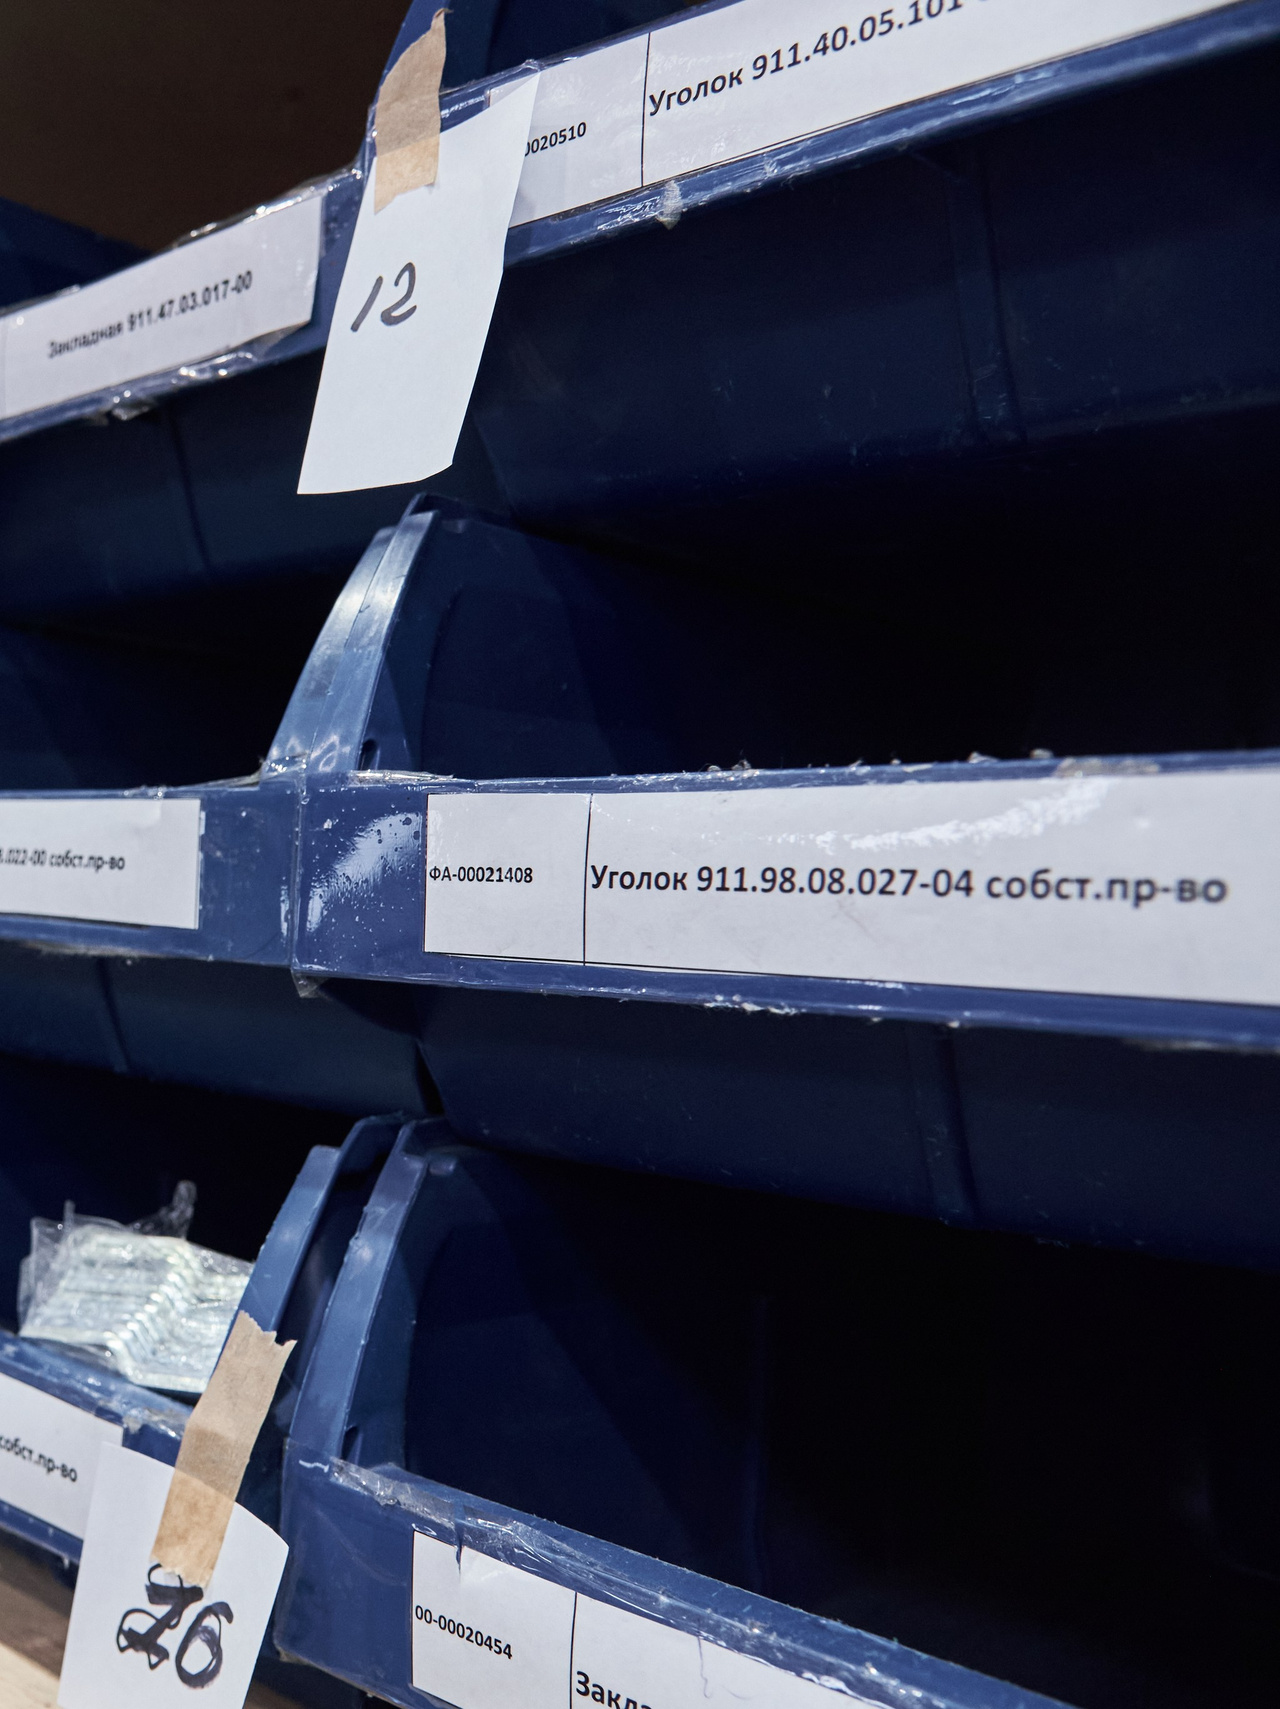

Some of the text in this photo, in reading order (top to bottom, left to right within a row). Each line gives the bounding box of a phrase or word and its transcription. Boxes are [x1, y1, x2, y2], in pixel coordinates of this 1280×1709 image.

[648, 67, 743, 116] Уголок
[48, 270, 254, 359] Закладная 911.47.03.017-00
[350, 262, 417, 332] 12
[49, 848, 126, 874] собст.пр-во
[429, 864, 1228, 909] ФА-00021408 Уголок 911.98.08.027-04 собст.пр-во
[415, 1604, 654, 1709] 00-00020454 Закл
